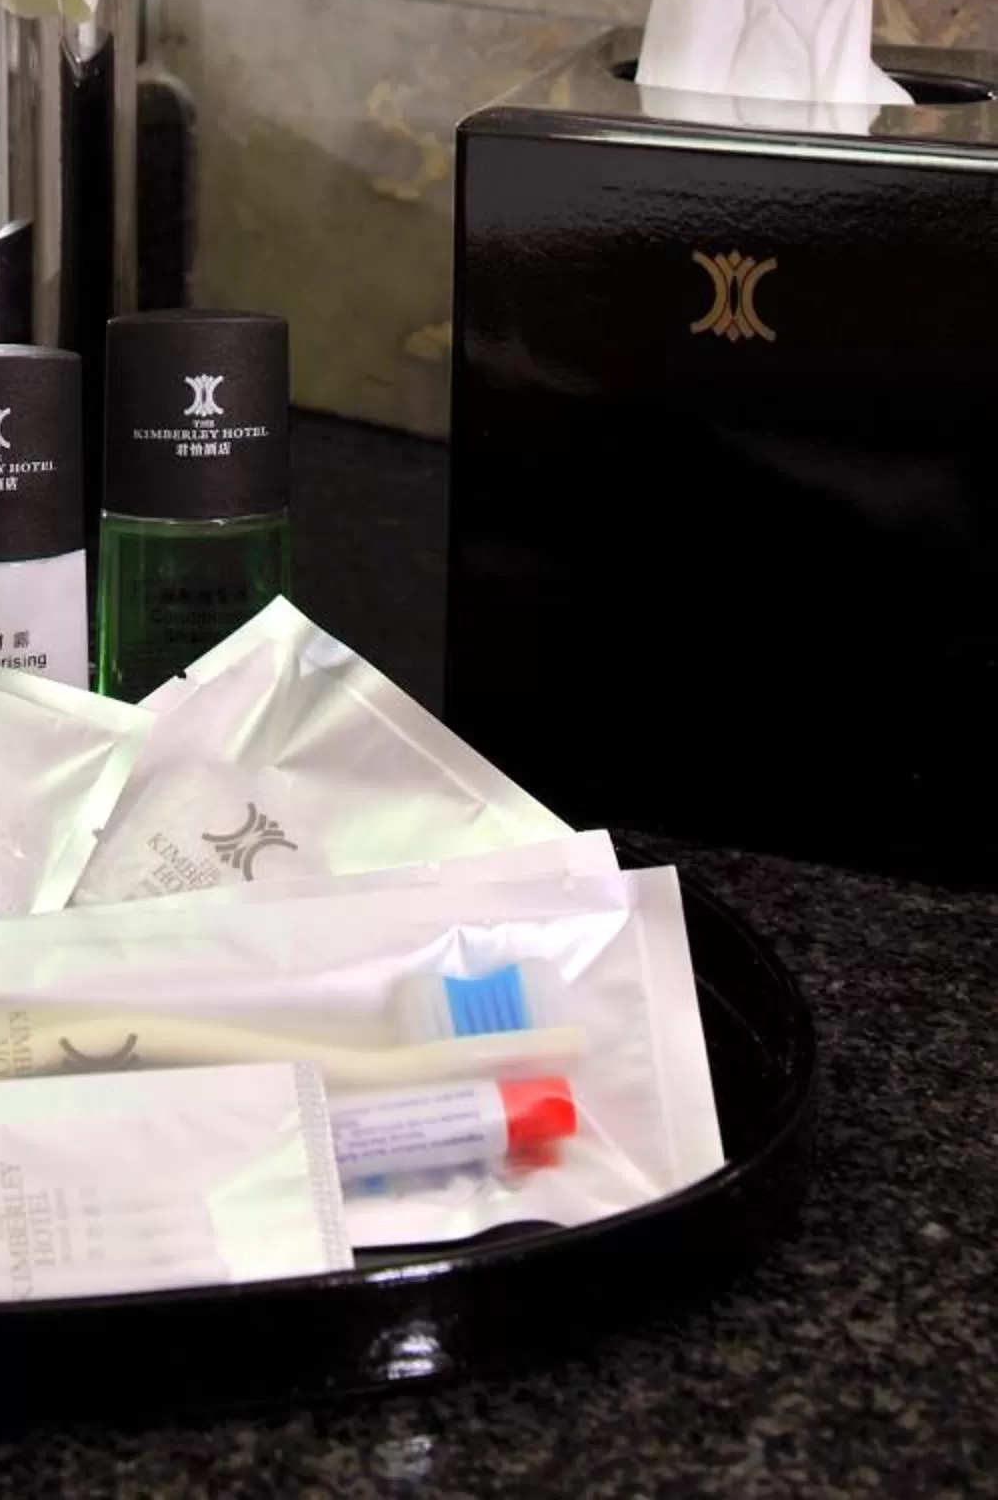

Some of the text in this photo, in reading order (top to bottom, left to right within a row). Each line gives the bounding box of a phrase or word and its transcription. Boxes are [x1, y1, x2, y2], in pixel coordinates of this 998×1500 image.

[192, 419, 215, 428] THE
[133, 426, 269, 441] KIMBERLEY HOTEL
[9, 460, 57, 473] HOTEL
[26, 1191, 57, 1267] HOTEL
